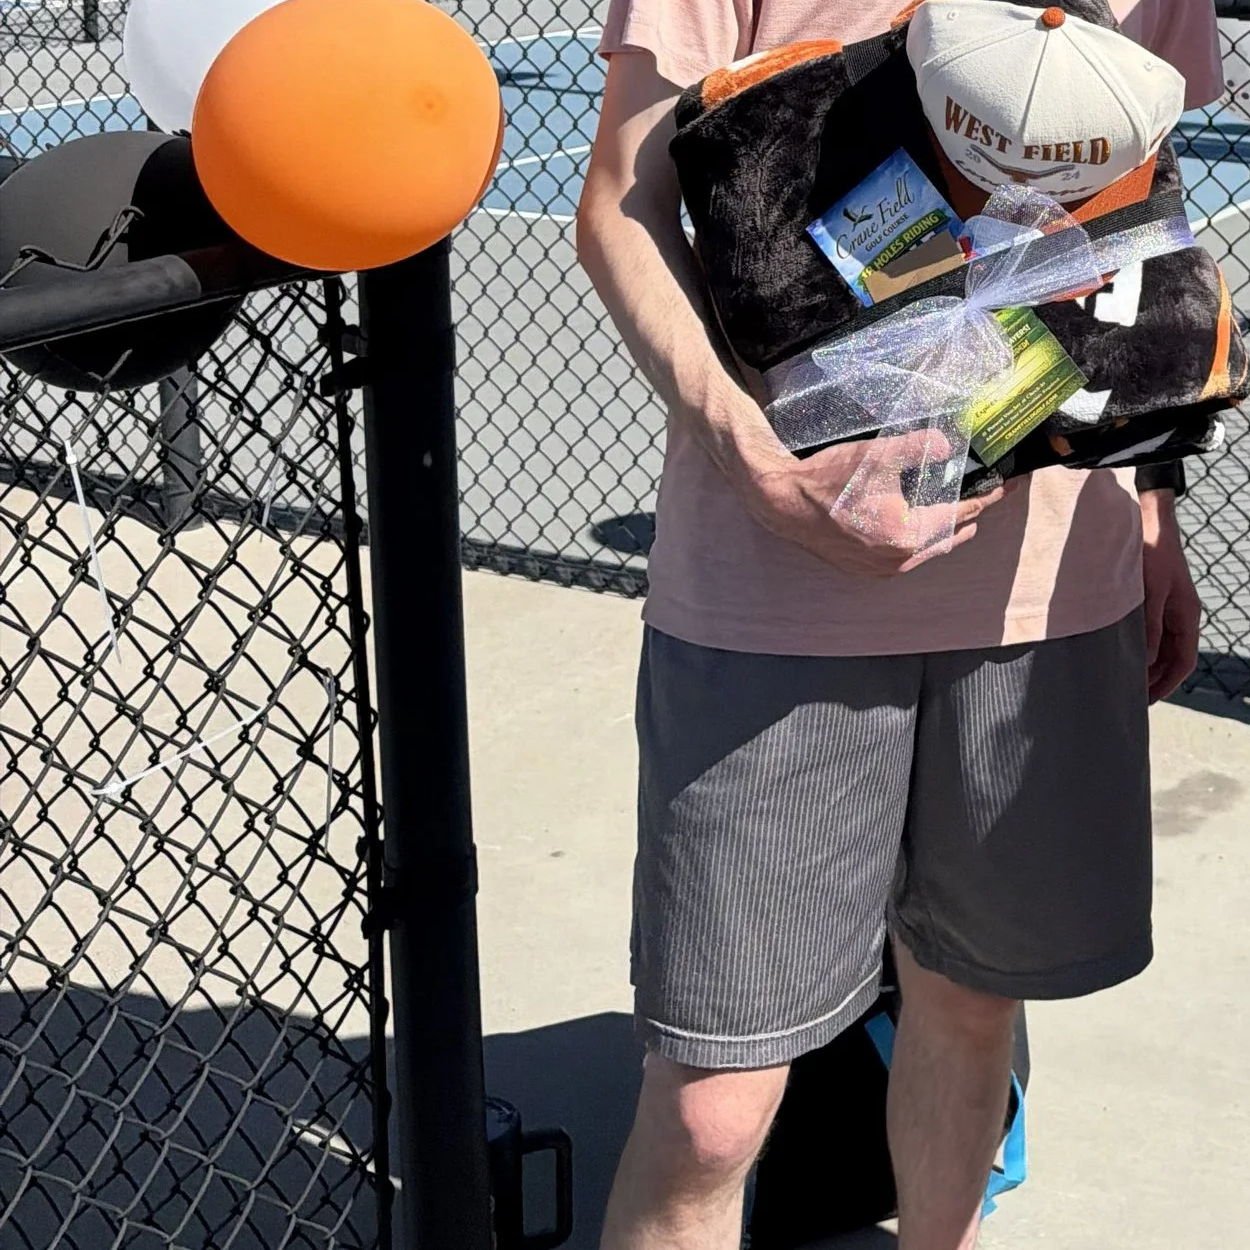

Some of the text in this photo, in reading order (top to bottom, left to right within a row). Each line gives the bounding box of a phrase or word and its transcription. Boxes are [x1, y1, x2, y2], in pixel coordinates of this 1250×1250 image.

[945, 95, 1111, 165] WEST FIELD
[965, 149, 1080, 181] 20 24
[836, 171, 915, 259] Crane Field
[865, 213, 910, 252] GOLF COURSE
[874, 239, 905, 271] HOLES
[903, 213, 940, 244] RIDING
